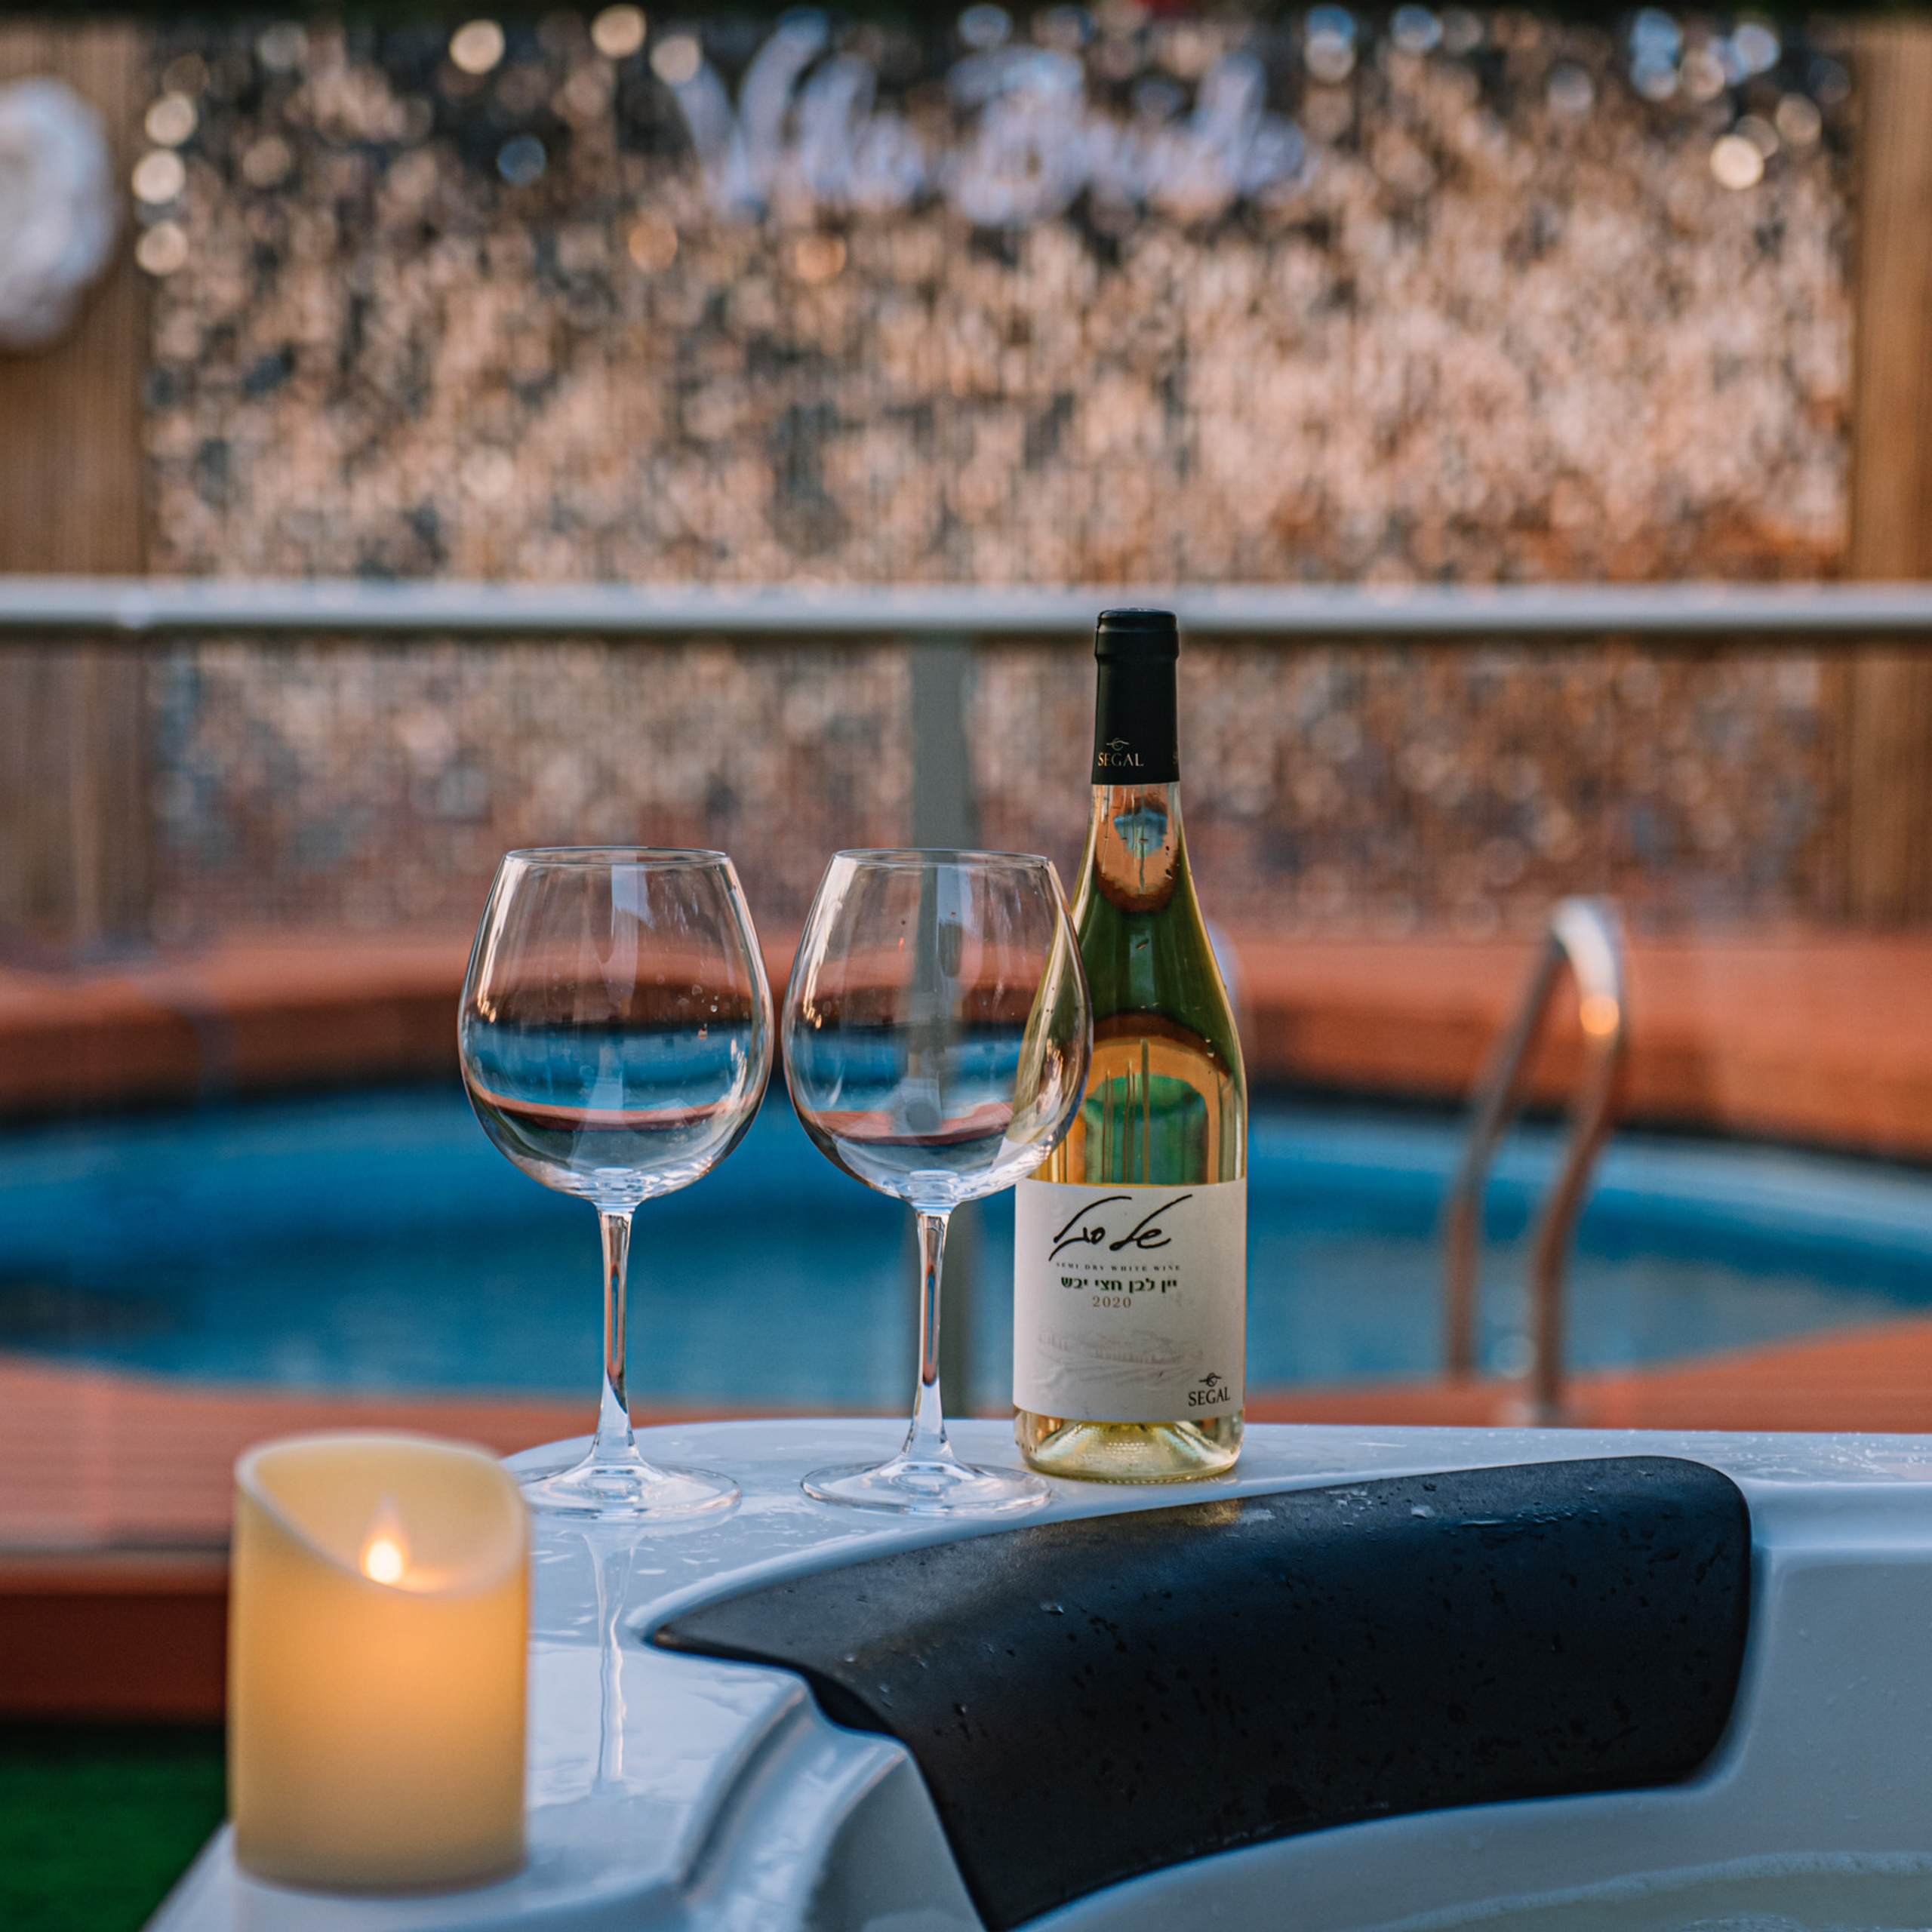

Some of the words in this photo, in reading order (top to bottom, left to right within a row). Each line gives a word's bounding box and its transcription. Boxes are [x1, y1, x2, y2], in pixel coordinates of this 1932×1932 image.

[1097, 752, 1144, 767] SEGAL
[1061, 1277, 1088, 1289] יבש
[1094, 1279, 1122, 1291] חצי
[1129, 1278, 1155, 1294] לבן
[1161, 1280, 1177, 1294] יין
[1093, 1296, 1132, 1308] 2020
[1188, 1386, 1231, 1407] SEGAL
